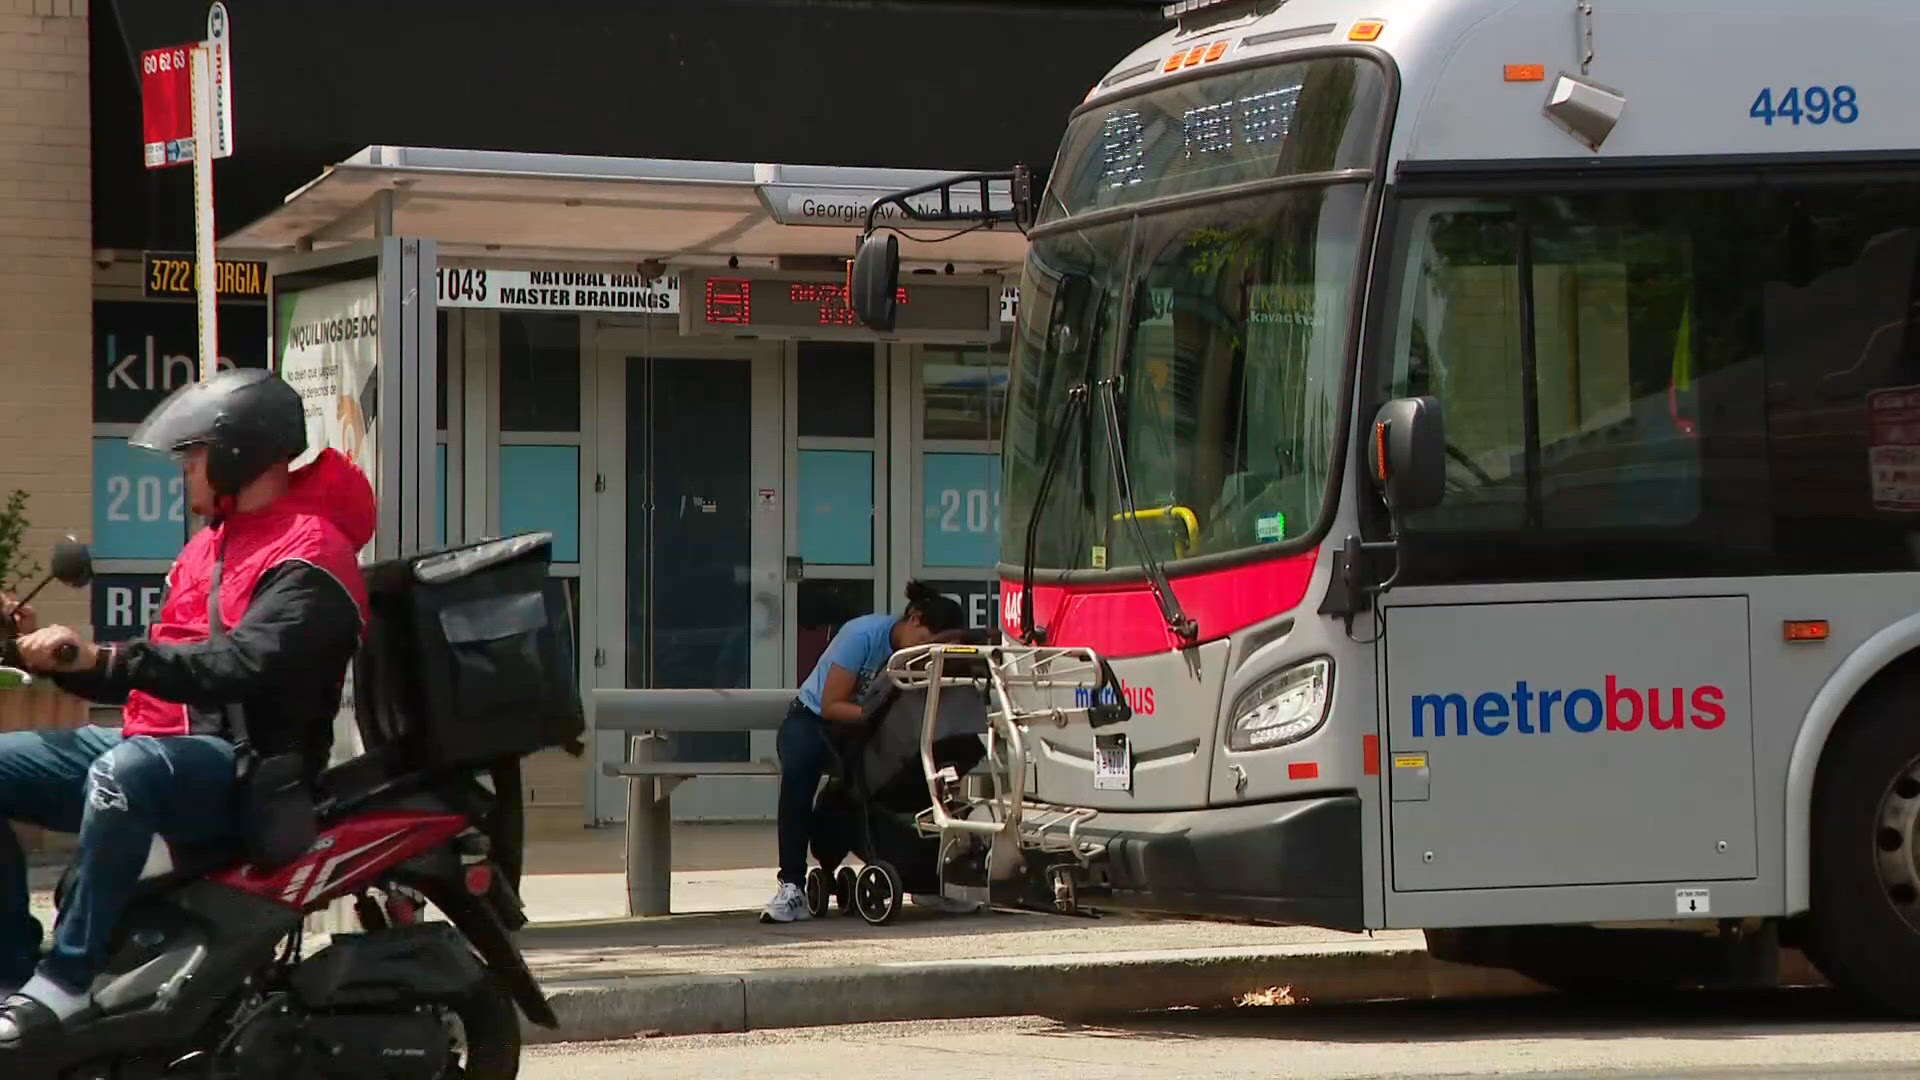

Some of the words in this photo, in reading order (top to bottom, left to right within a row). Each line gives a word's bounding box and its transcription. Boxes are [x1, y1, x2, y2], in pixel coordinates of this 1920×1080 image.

[144, 55, 157, 74] 60
[159, 52, 171, 71] 62
[173, 50, 185, 69] 63
[215, 43, 224, 150] metrobus
[1749, 85, 1859, 126] 4498
[803, 199, 867, 222] Georgia
[875, 204, 894, 218] Av
[151, 260, 190, 291] 3722
[194, 261, 260, 294] ORGIA
[437, 268, 487, 301] 1043
[530, 271, 606, 287] NATURAL
[500, 288, 570, 307] MASTER
[576, 291, 670, 309] BRAIDINGS
[290, 319, 343, 351] INQUILINOS
[345, 317, 359, 340] DE
[107, 335, 237, 390] kln
[107, 475, 184, 521] 202
[940, 489, 1000, 532] 20
[1075, 679, 1155, 716] mrbus
[1411, 675, 1727, 738] metrobus
